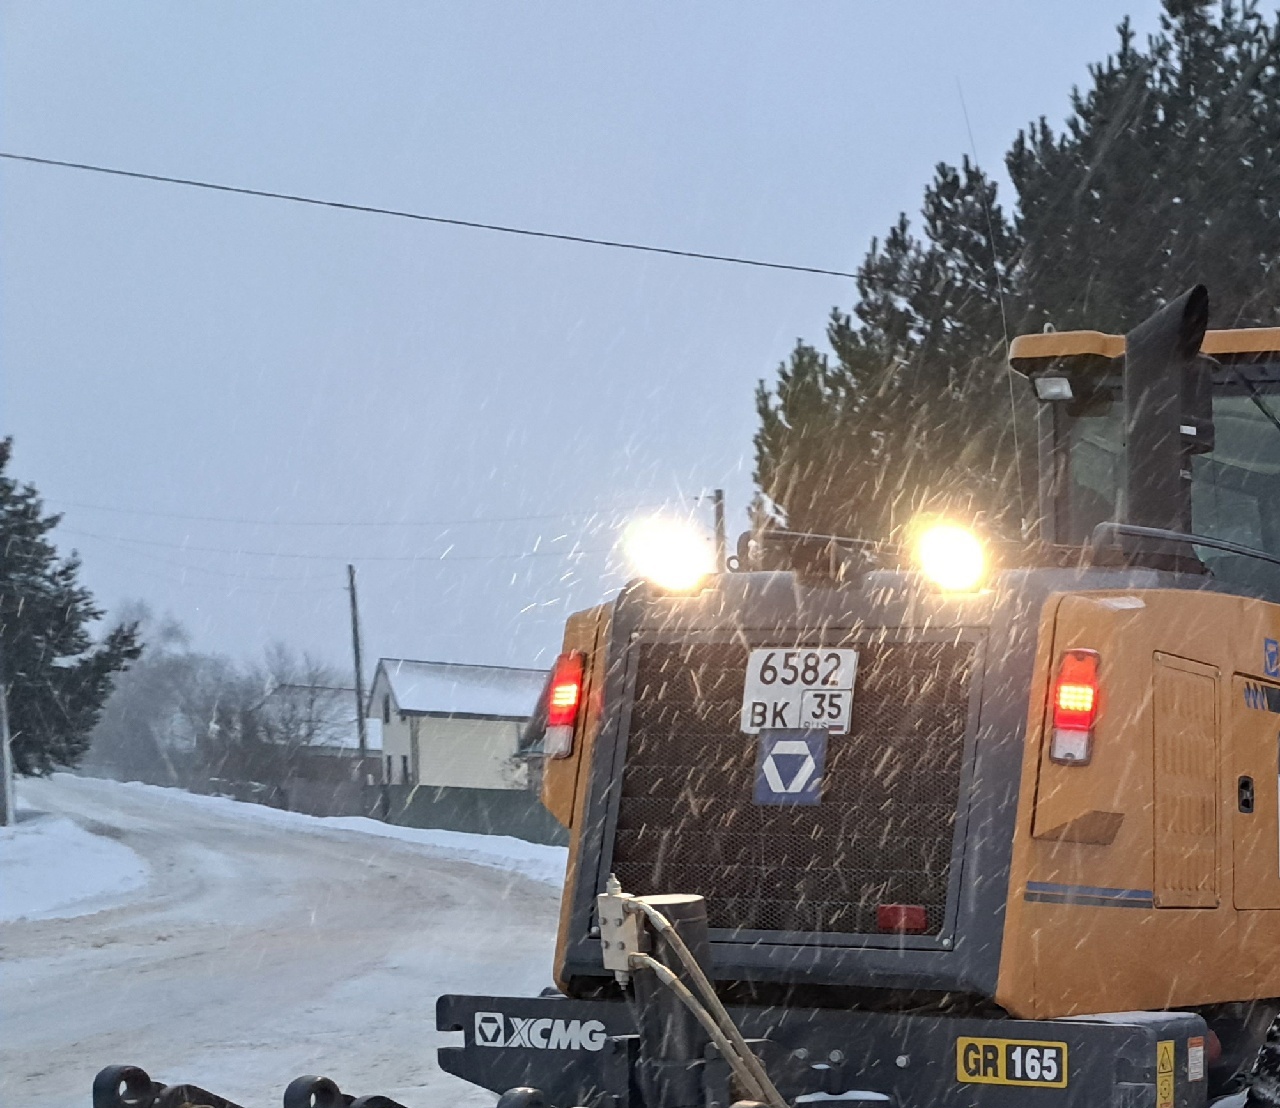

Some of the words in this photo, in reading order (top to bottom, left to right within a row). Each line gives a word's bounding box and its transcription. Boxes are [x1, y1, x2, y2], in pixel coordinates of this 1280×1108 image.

[759, 652, 842, 686] 6582
[811, 693, 842, 720] 35
[504, 1017, 607, 1051] XCMG
[963, 1043, 999, 1078] GR
[1011, 1046, 1058, 1081] 165
